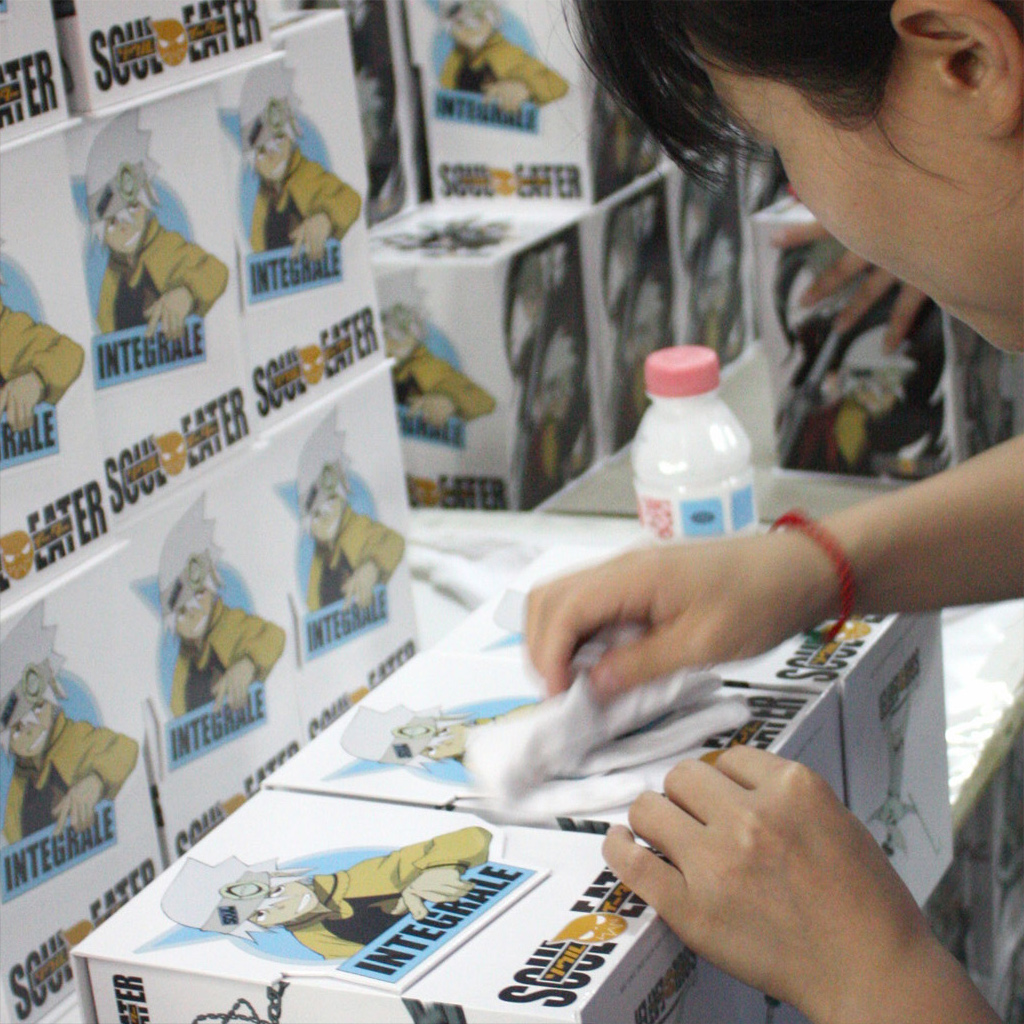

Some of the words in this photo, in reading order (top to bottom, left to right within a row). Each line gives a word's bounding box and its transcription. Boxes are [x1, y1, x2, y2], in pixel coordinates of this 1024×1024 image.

[90, 17, 164, 91] SOUL
[182, 0, 263, 63] EATER
[0, 50, 58, 128] ATER
[250, 246, 340, 296] INTEGRALE
[97, 322, 203, 380] INTEGRALE
[252, 346, 307, 416] SOUL
[320, 306, 379, 378] EATER
[0, 410, 55, 460] RALE
[104, 434, 168, 514] SOUL
[180, 387, 249, 469] EATER
[26, 480, 108, 573] EATER
[307, 589, 386, 653] INTEGRALE
[170, 689, 265, 762] INTEGRALE
[4, 806, 114, 891] INTEGRALE
[355, 866, 524, 976] INTEGRALE
[498, 939, 618, 1007] SOUL
[570, 866, 650, 918] EAT
[9, 930, 74, 1021] SOUL
[113, 974, 150, 1024] ATER
